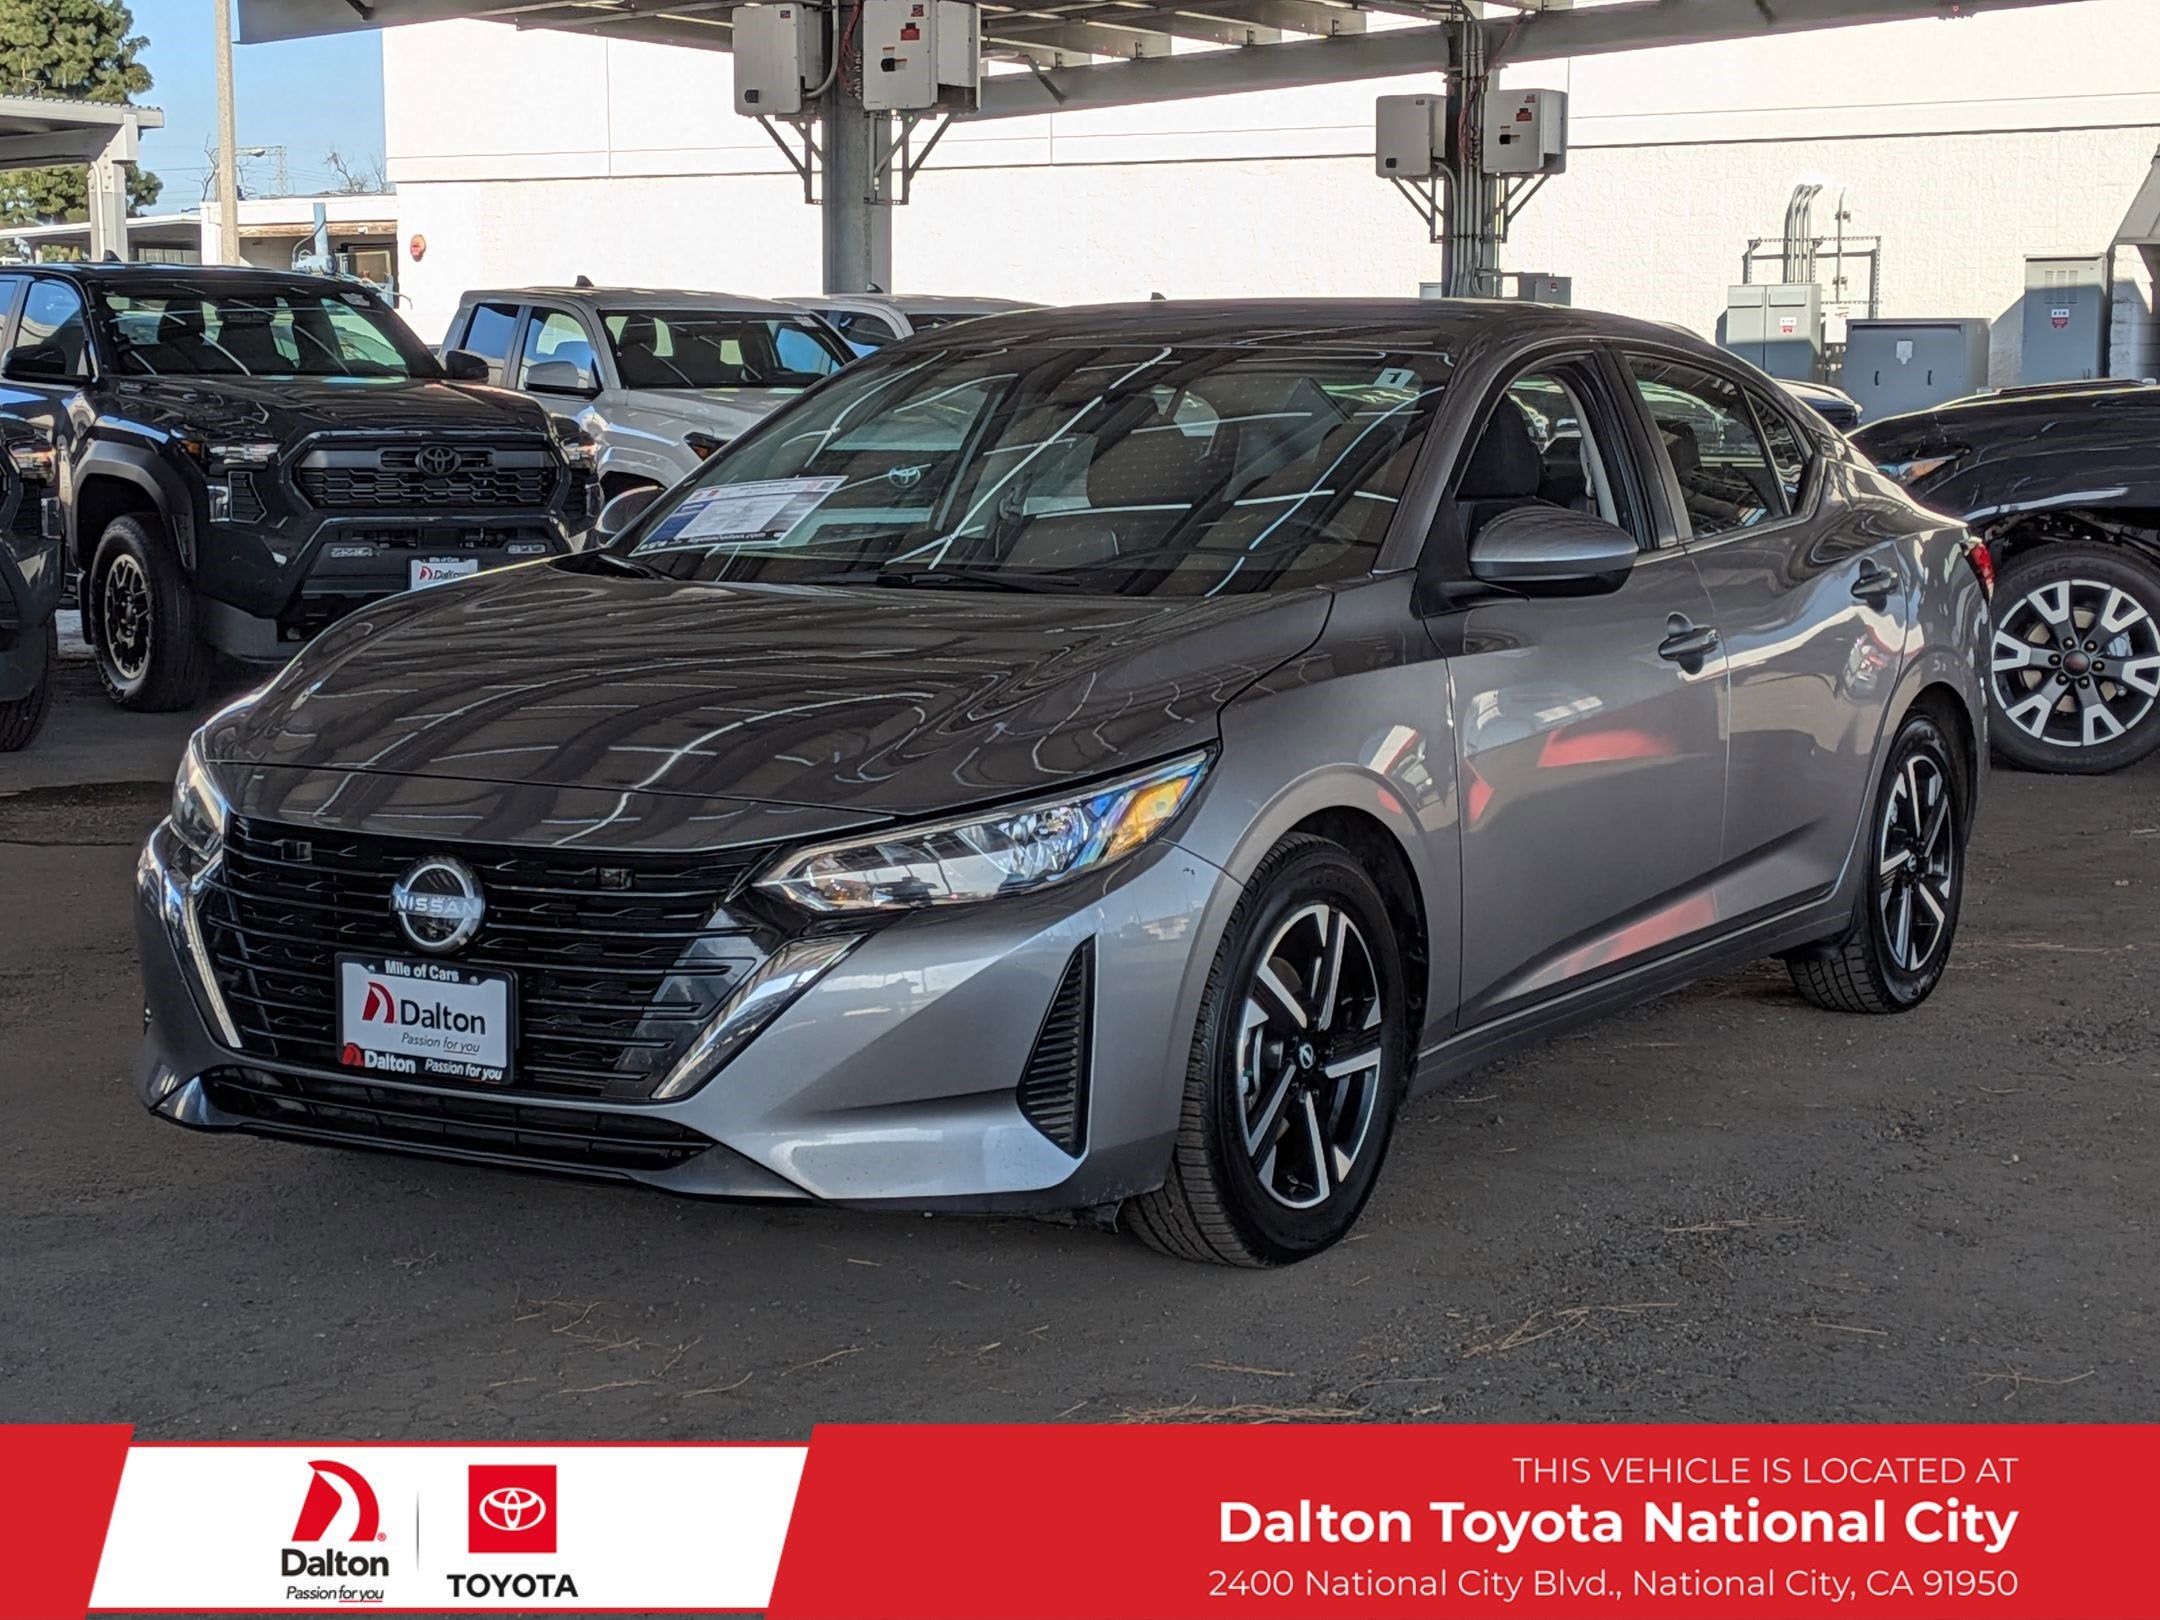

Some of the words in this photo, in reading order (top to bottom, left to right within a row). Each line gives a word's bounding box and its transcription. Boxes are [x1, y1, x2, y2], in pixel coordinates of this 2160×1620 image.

[394, 894, 478, 915] NISSAN
[384, 960, 411, 977] Mile
[413, 963, 428, 978] of
[429, 966, 460, 982] Cars
[400, 999, 486, 1035] Dalton
[401, 1032, 441, 1048] Passion
[443, 1036, 458, 1049] for
[460, 1041, 481, 1053] you
[364, 1050, 416, 1073] Dalton
[424, 1058, 464, 1076] Passion
[465, 1064, 482, 1078] for
[481, 1068, 503, 1081] you
